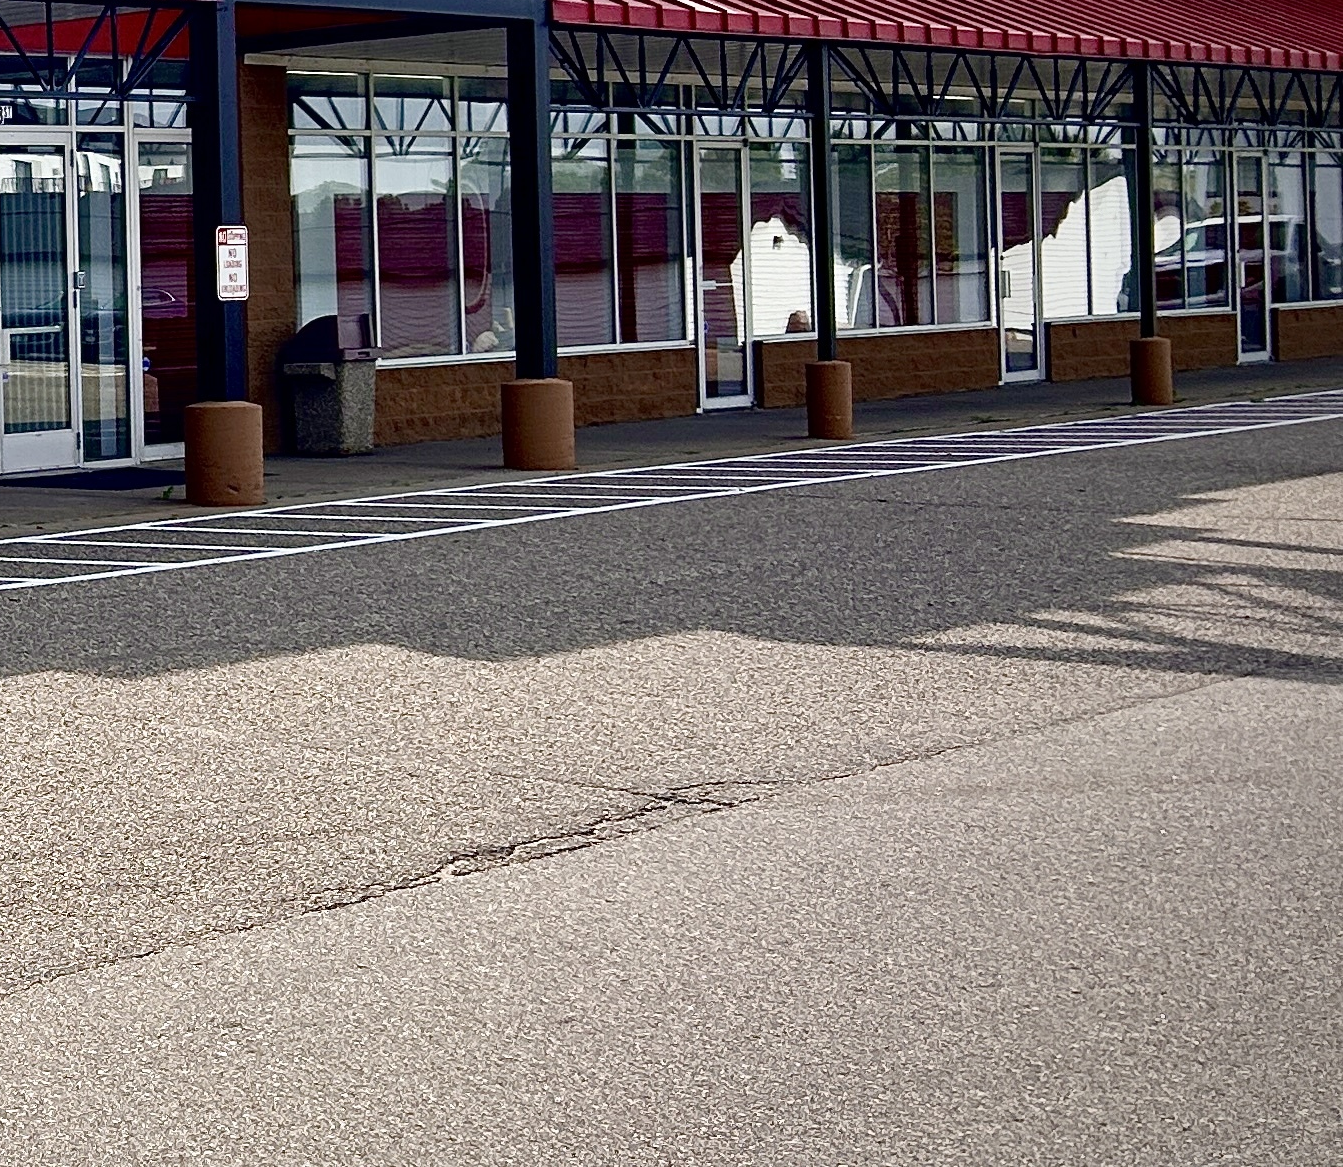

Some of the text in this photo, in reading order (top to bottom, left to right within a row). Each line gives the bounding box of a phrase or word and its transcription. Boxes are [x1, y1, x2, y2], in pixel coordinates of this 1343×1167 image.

[218, 231, 227, 243] NO
[228, 248, 237, 258] NO
[229, 273, 238, 282] NO
